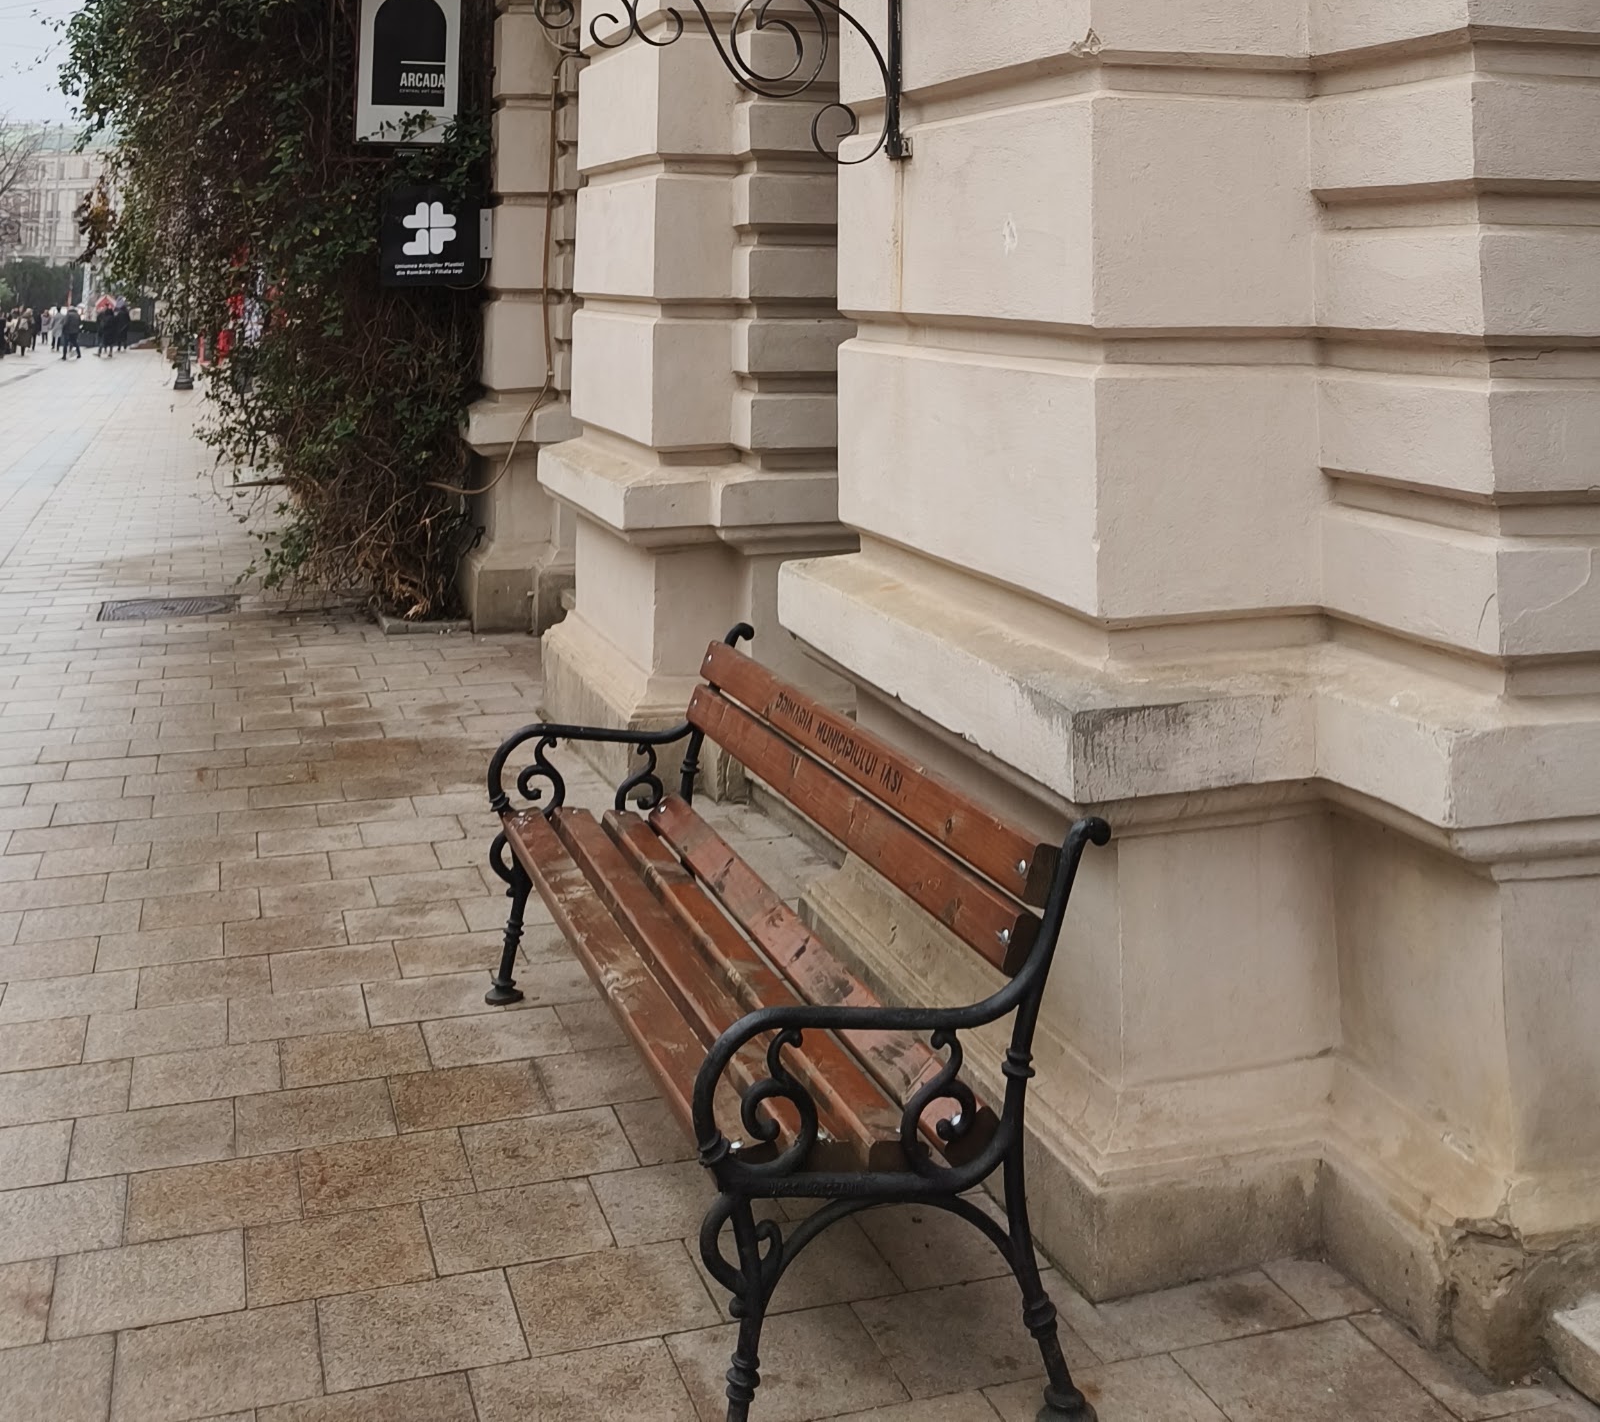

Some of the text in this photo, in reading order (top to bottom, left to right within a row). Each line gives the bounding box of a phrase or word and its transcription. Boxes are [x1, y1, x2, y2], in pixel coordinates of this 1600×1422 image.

[400, 72, 445, 88] ARCADA
[815, 720, 879, 778] MUNICIPIULUI
[879, 761, 905, 795] IASI
